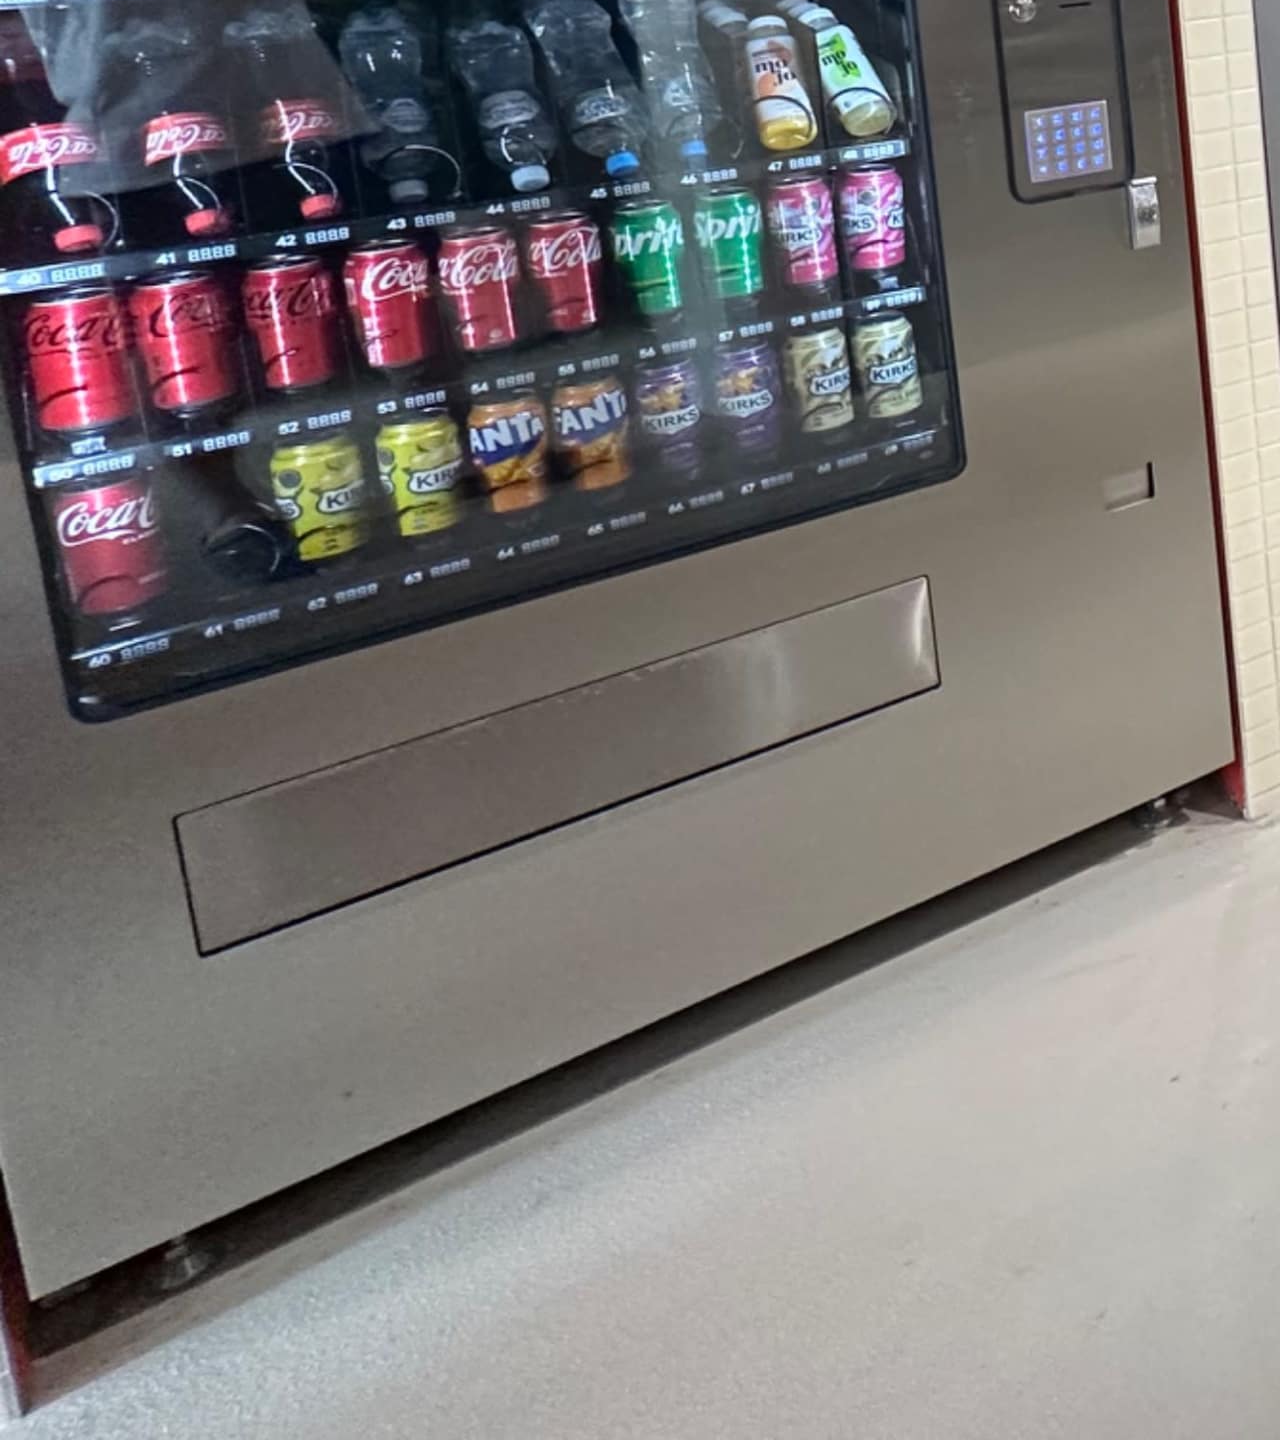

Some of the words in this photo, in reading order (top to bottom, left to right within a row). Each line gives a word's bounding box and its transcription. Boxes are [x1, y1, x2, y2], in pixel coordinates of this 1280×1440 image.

[590, 187, 607, 199] 45
[486, 203, 505, 214] 44
[386, 218, 407, 230] 43
[275, 235, 297, 247] 42
[156, 253, 176, 265] 41
[470, 382, 489, 395] 54
[720, 391, 771, 409] KIRKS
[377, 401, 397, 414] 53
[645, 407, 699, 432] KIRKS
[278, 422, 300, 435] 52
[172, 444, 192, 457] 51
[88, 653, 111, 668] 60
